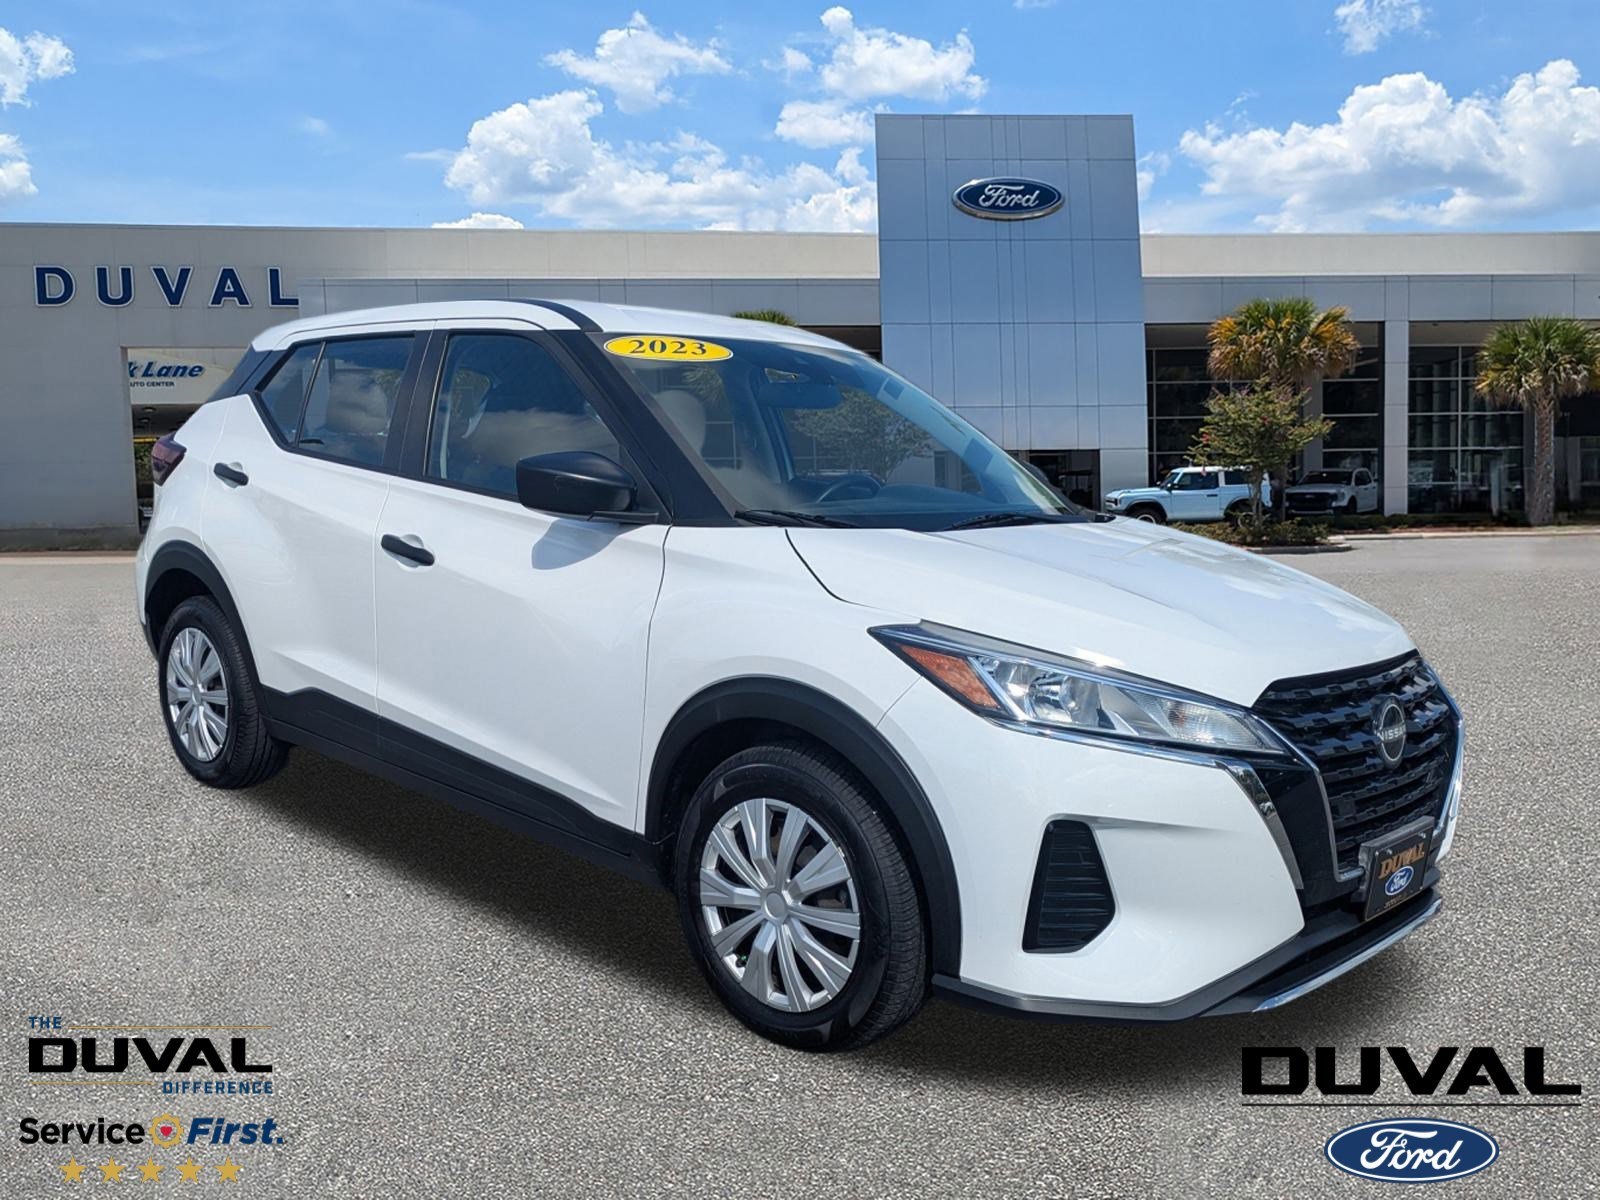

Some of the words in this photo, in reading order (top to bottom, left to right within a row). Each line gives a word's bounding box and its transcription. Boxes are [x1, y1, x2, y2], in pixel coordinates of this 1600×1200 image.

[979, 184, 1040, 207] Ford
[33, 266, 299, 307] DUVAL
[629, 339, 707, 356] 2023
[141, 361, 206, 378] Lane
[1379, 842, 1425, 879] DUVAL
